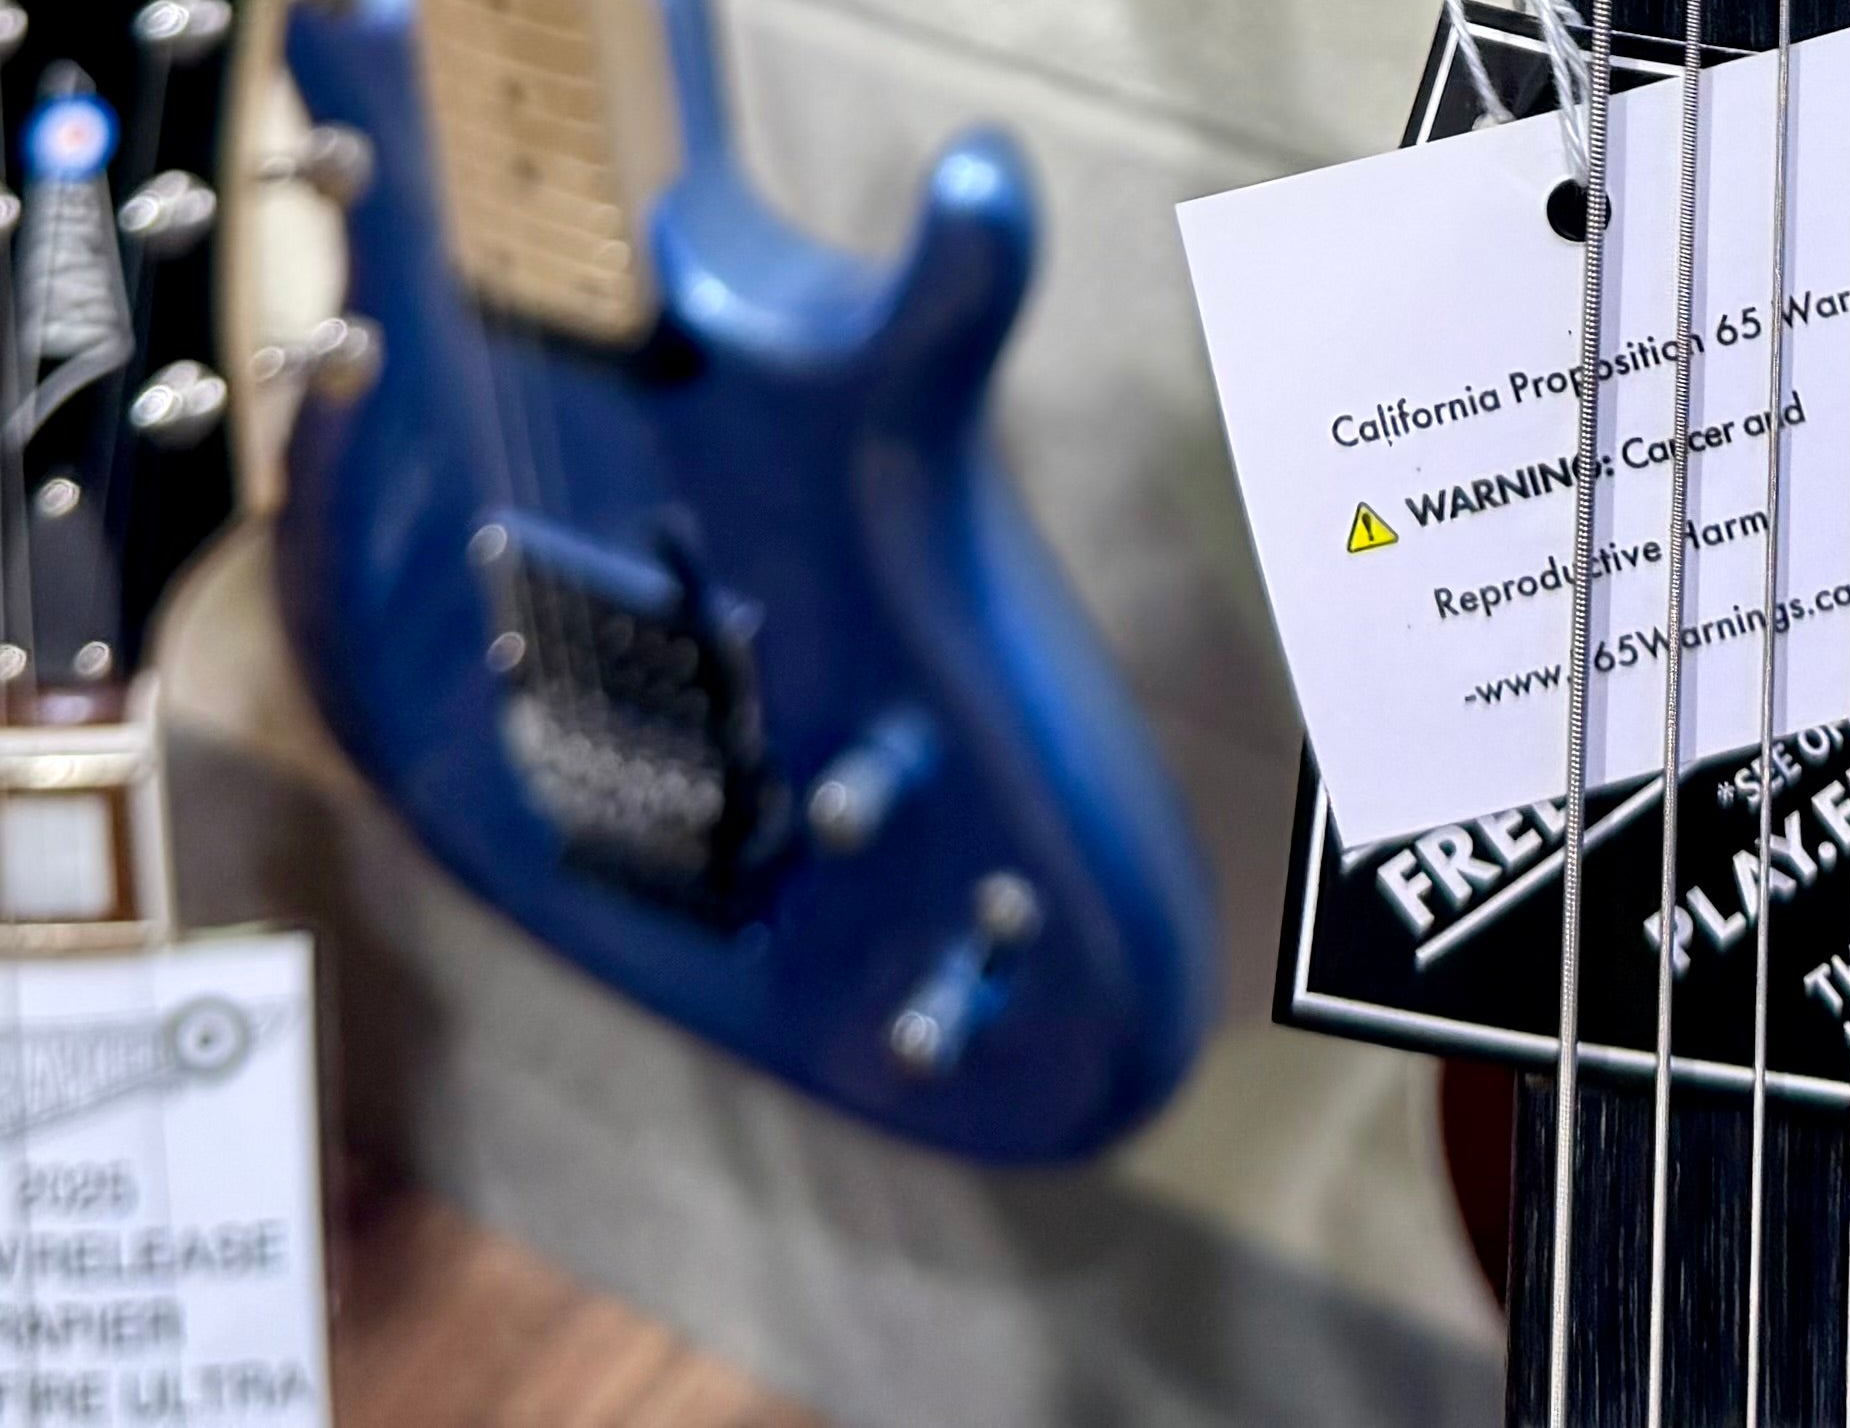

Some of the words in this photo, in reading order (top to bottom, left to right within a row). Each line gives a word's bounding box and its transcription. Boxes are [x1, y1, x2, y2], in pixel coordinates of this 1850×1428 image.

[1332, 384, 1500, 448] California
[1715, 306, 1762, 346] 65
[1405, 454, 1616, 528] WARNING:
[1743, 390, 1807, 437] and
